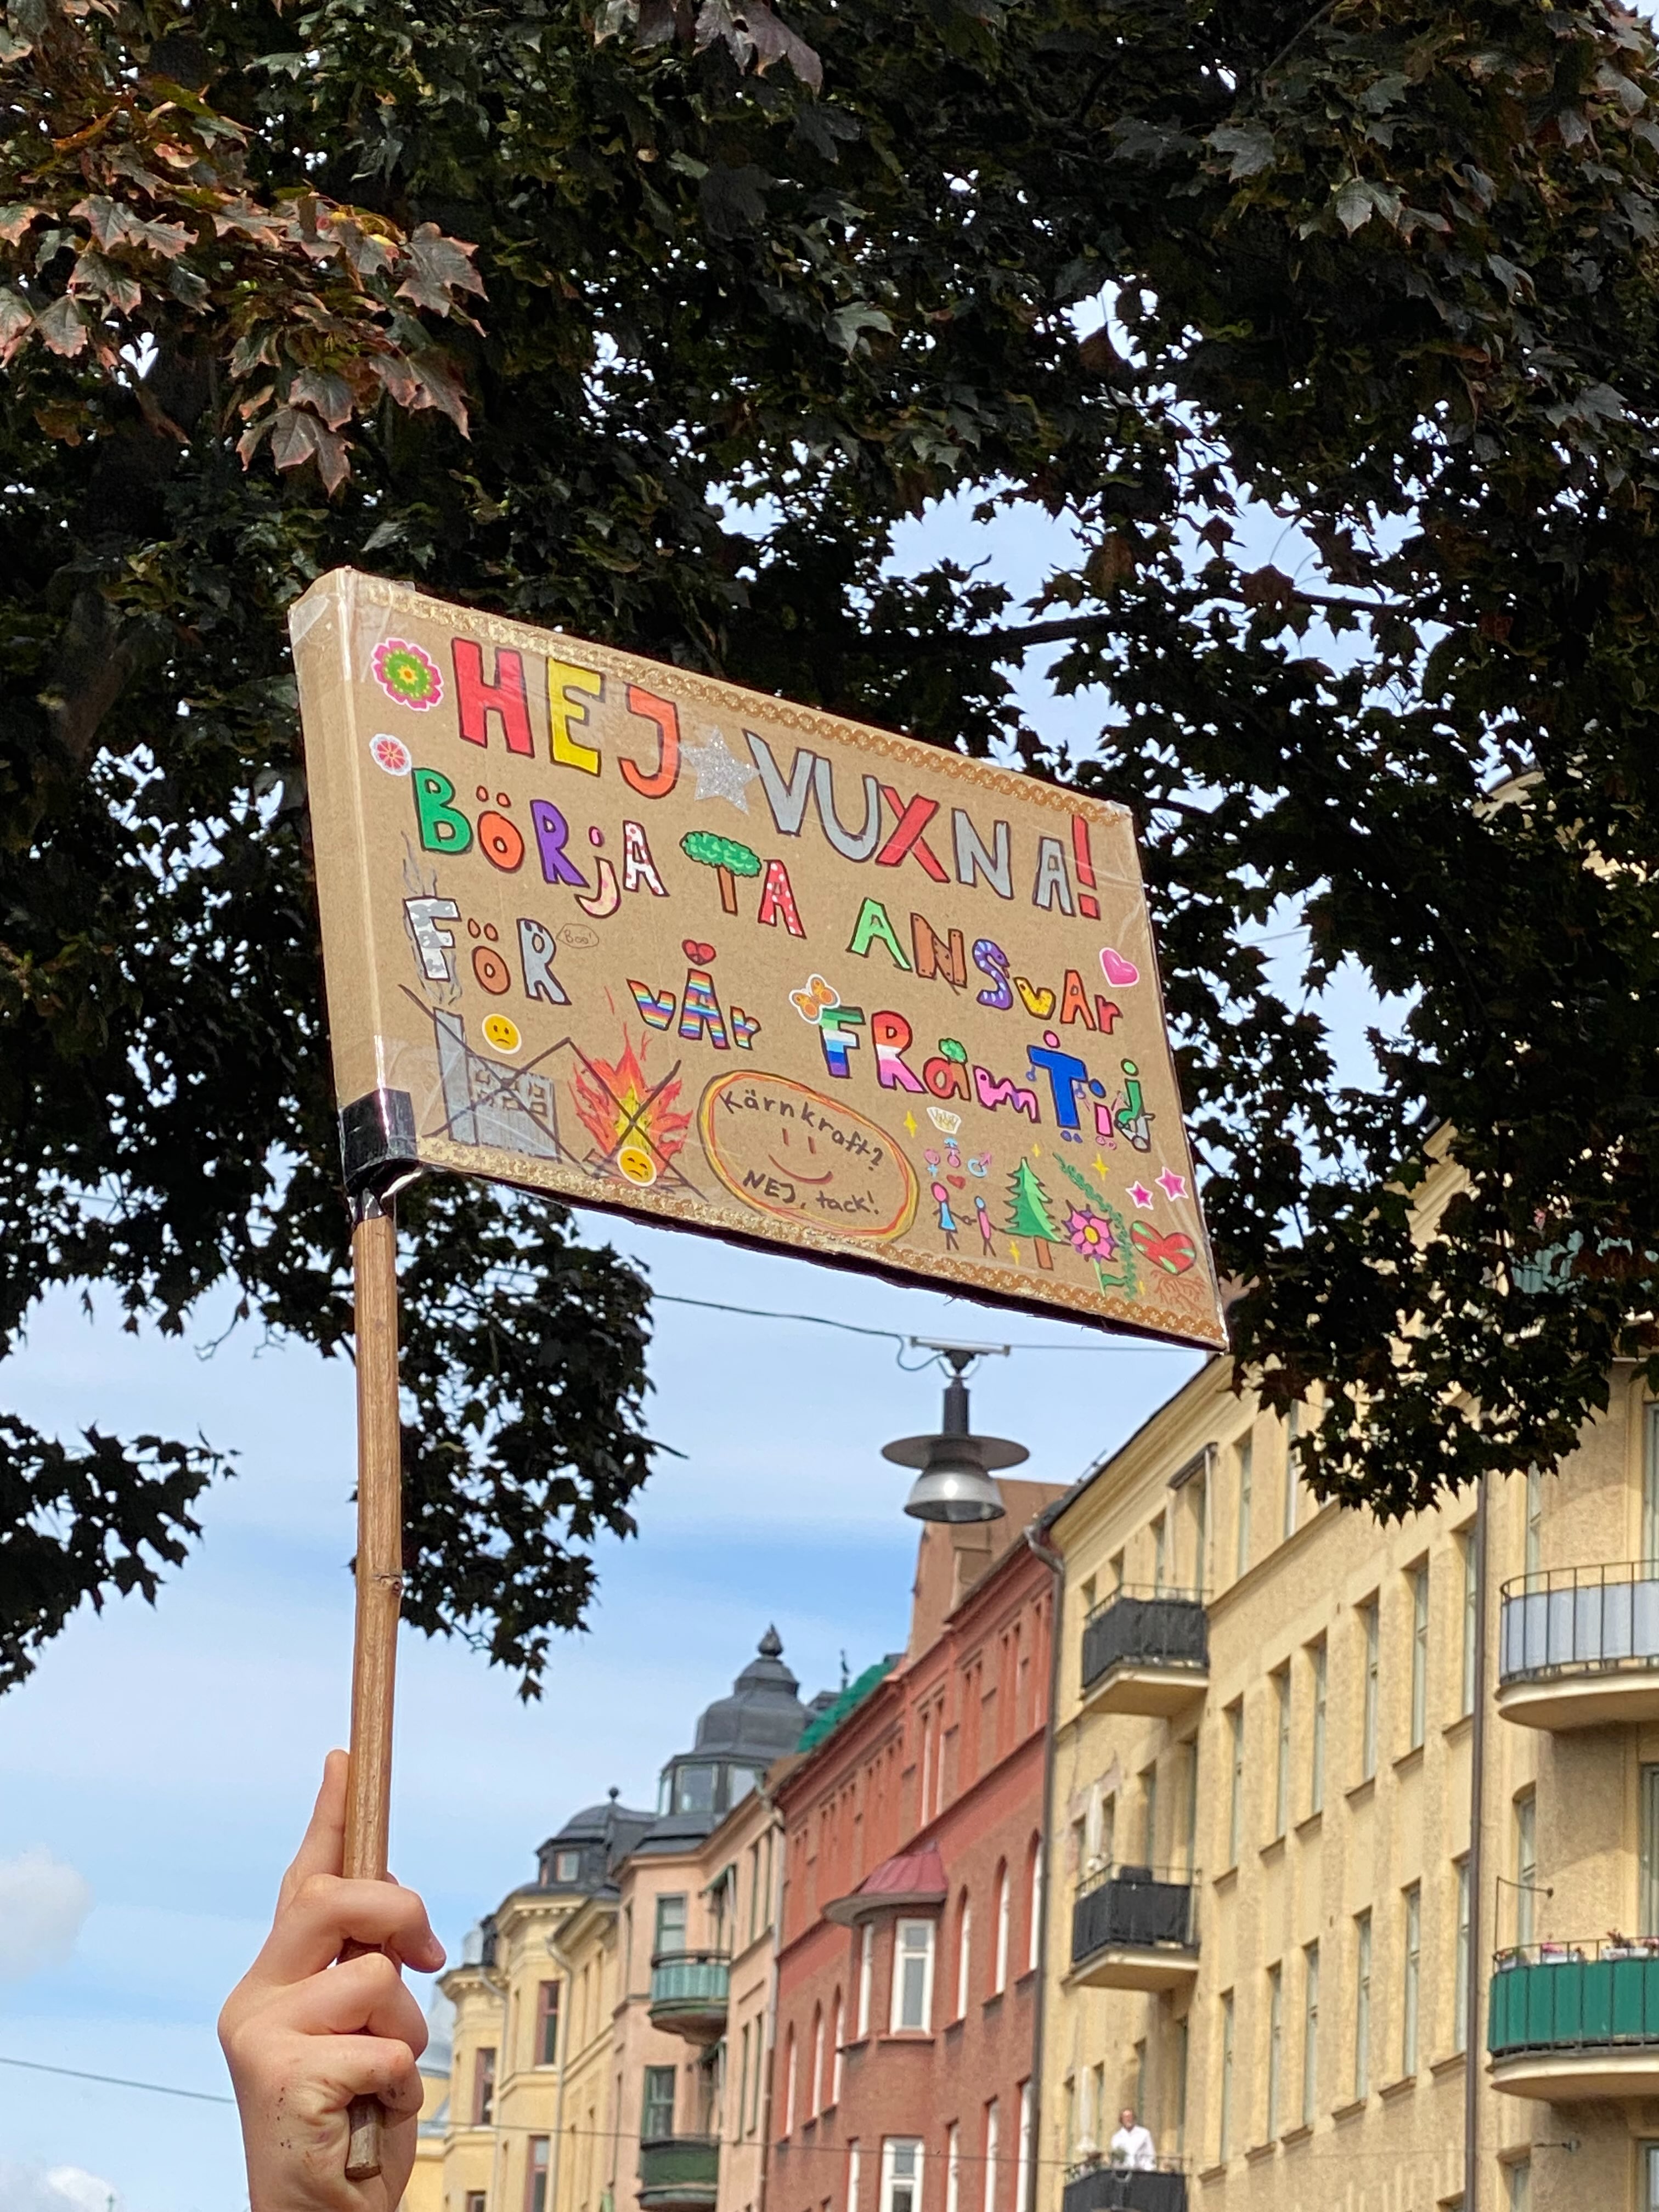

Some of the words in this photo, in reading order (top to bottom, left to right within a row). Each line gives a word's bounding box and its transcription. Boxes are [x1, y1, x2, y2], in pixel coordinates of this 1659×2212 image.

[451, 637, 682, 800] HEJ
[742, 729, 1101, 920] VUXNA!
[680, 831, 806, 939] TA
[816, 1190, 879, 1215] tack!
